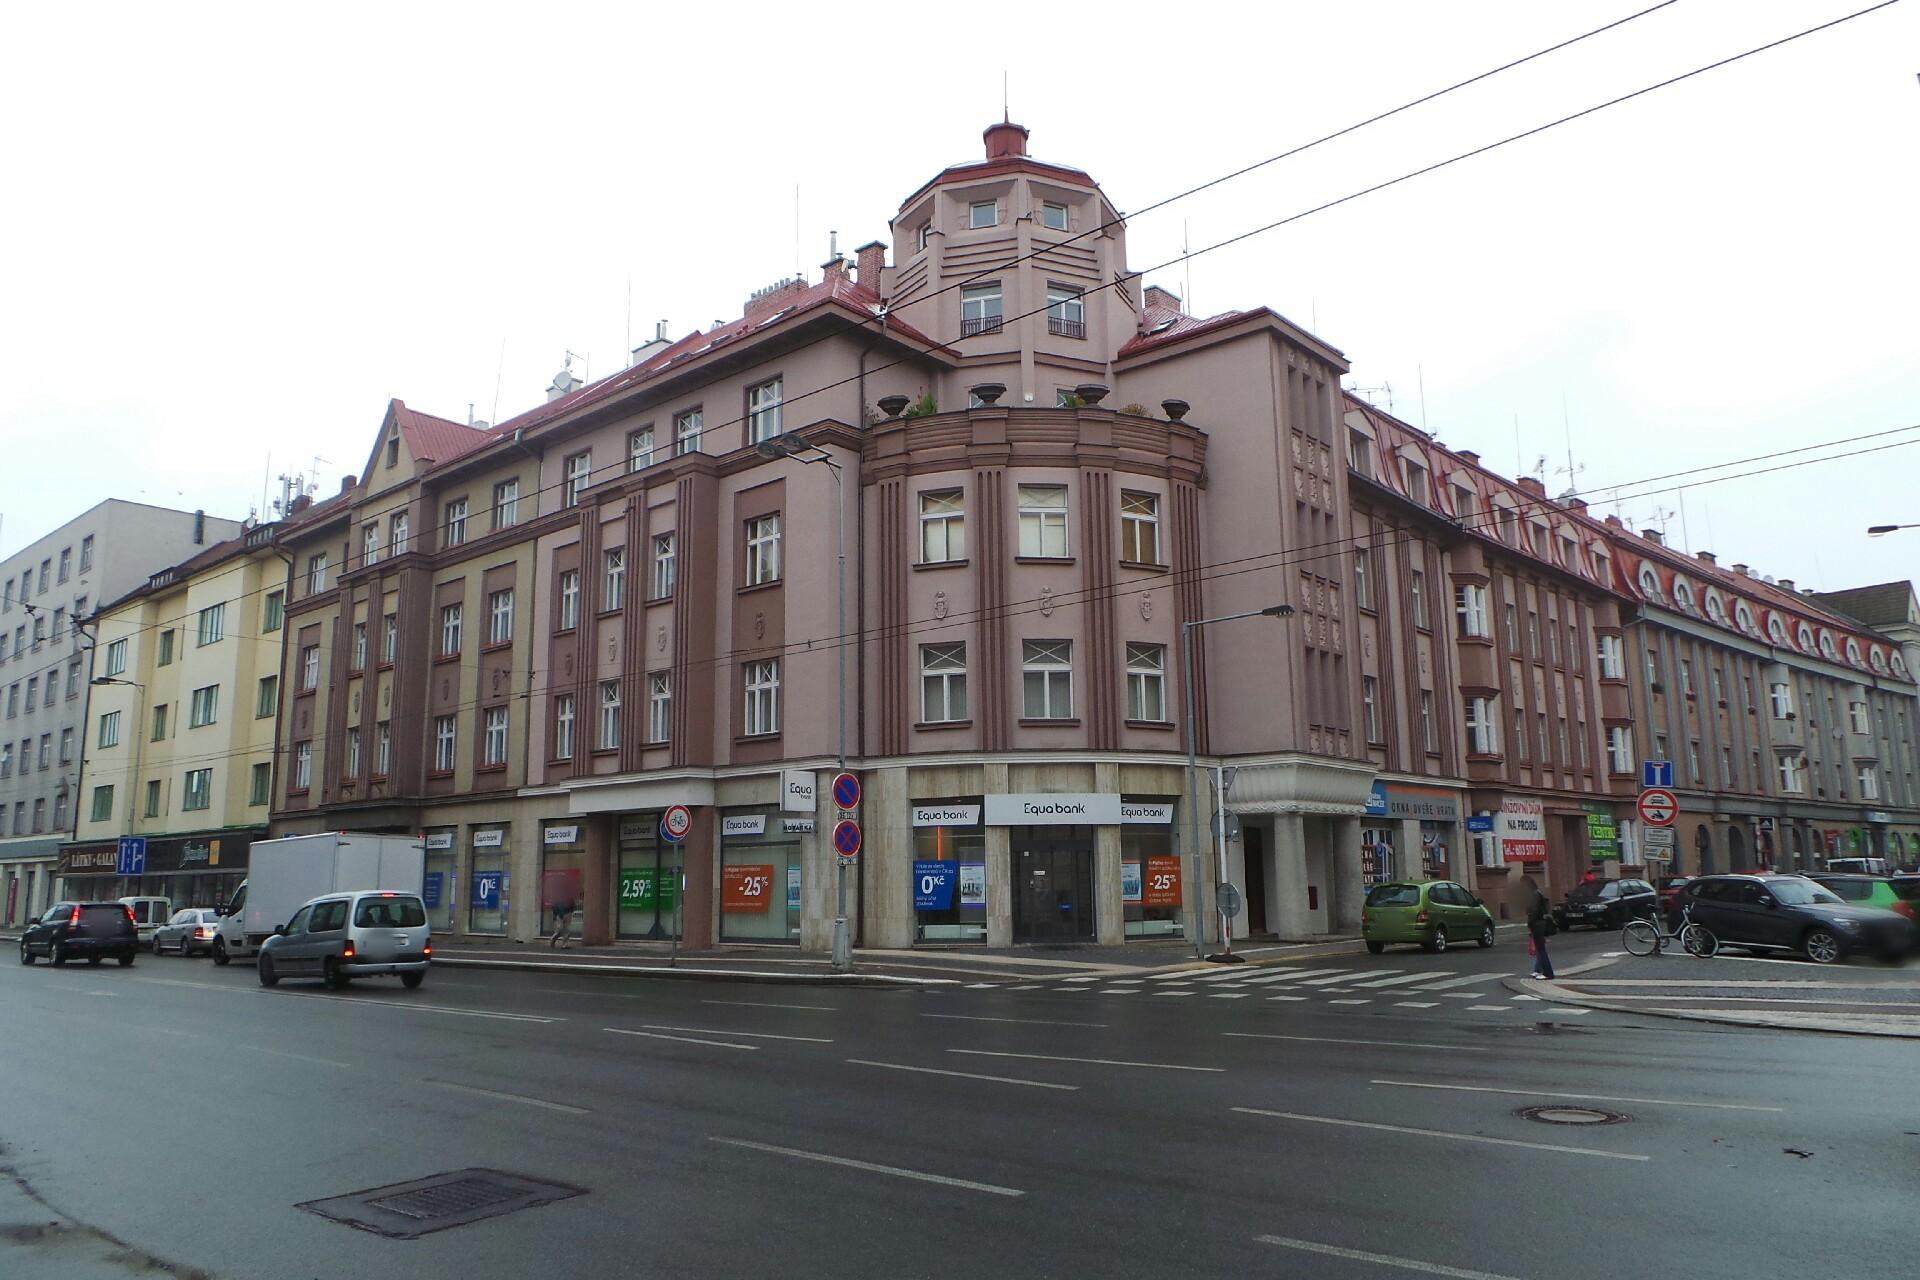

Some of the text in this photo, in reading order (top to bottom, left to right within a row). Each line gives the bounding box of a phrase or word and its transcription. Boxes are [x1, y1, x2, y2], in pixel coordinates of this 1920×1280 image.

[790, 783, 812, 795] Equa
[1024, 803, 1086, 816] Equa bank
[1121, 807, 1165, 818] Equa bank
[918, 810, 968, 821] Equa bank
[727, 820, 759, 830] Equa bank
